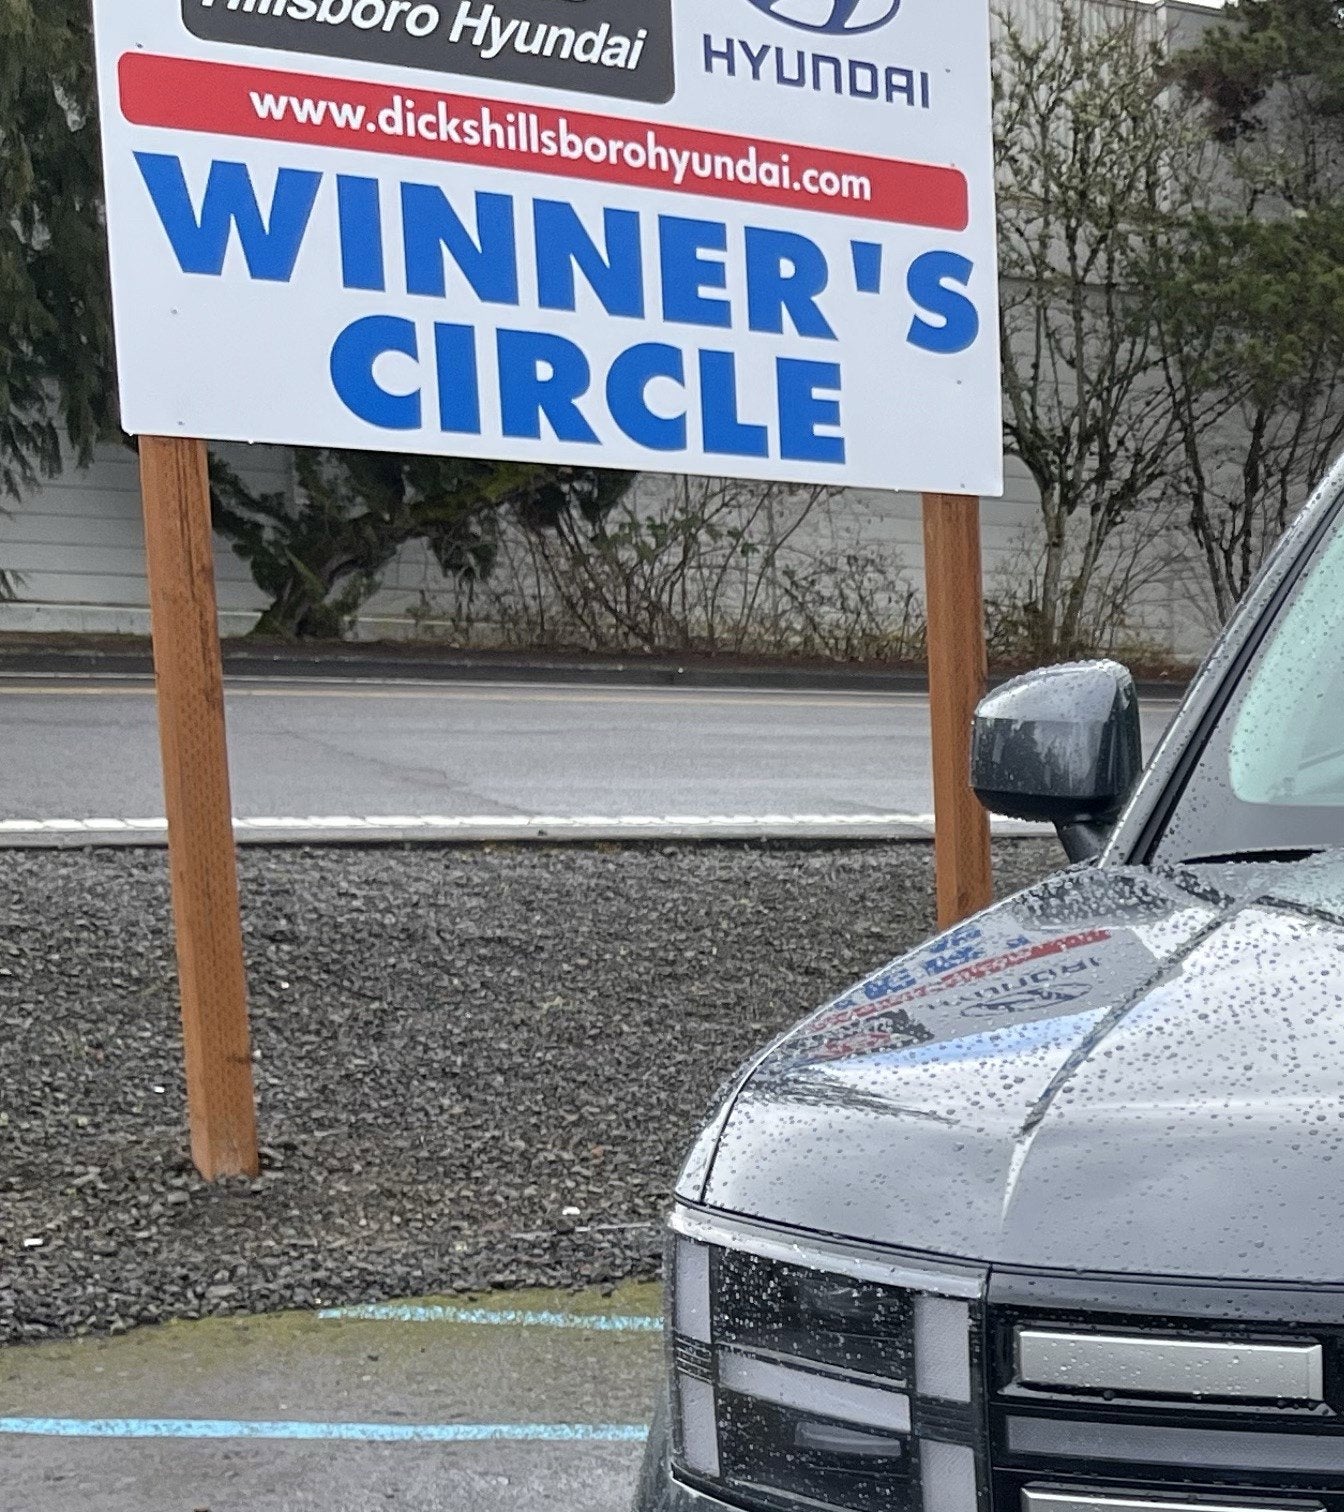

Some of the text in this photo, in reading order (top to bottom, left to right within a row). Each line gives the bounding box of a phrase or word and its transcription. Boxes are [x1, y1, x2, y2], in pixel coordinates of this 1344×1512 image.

[201, 0, 649, 71] sboro Hyundai
[703, 33, 930, 109] HYUNDAI
[249, 91, 873, 202] www.dickshillsborohyundai.com
[133, 150, 980, 354] WINNER'S
[329, 314, 846, 465] CIRCLE
